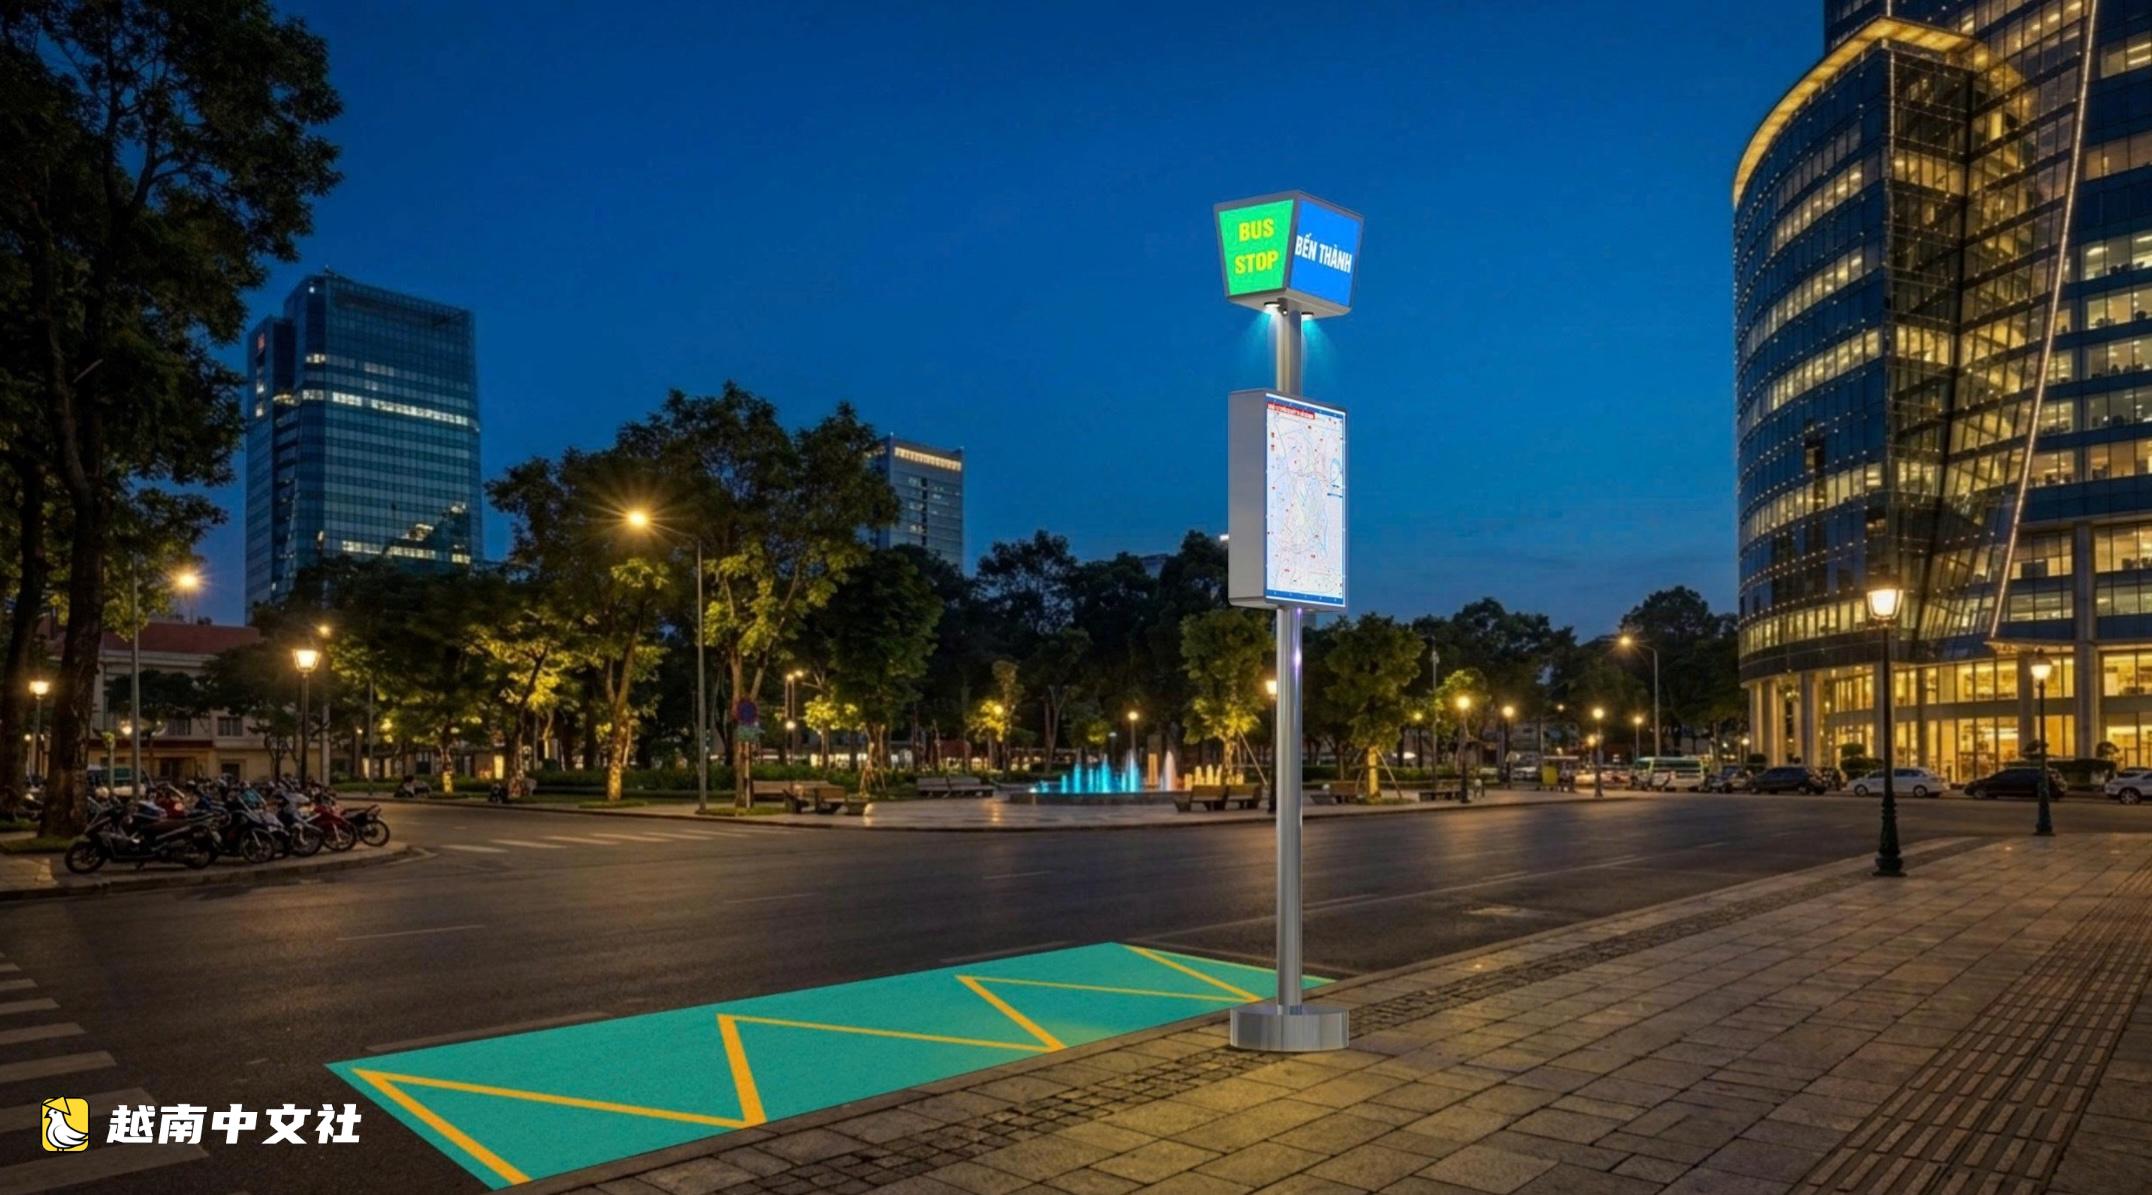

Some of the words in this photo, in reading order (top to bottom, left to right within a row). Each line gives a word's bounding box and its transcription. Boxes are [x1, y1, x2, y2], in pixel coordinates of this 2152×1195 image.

[1238, 218, 1275, 242] BUS
[1234, 250, 1279, 275] STOP
[1294, 232, 1318, 262] BẾN
[1319, 243, 1353, 273] THÀNH
